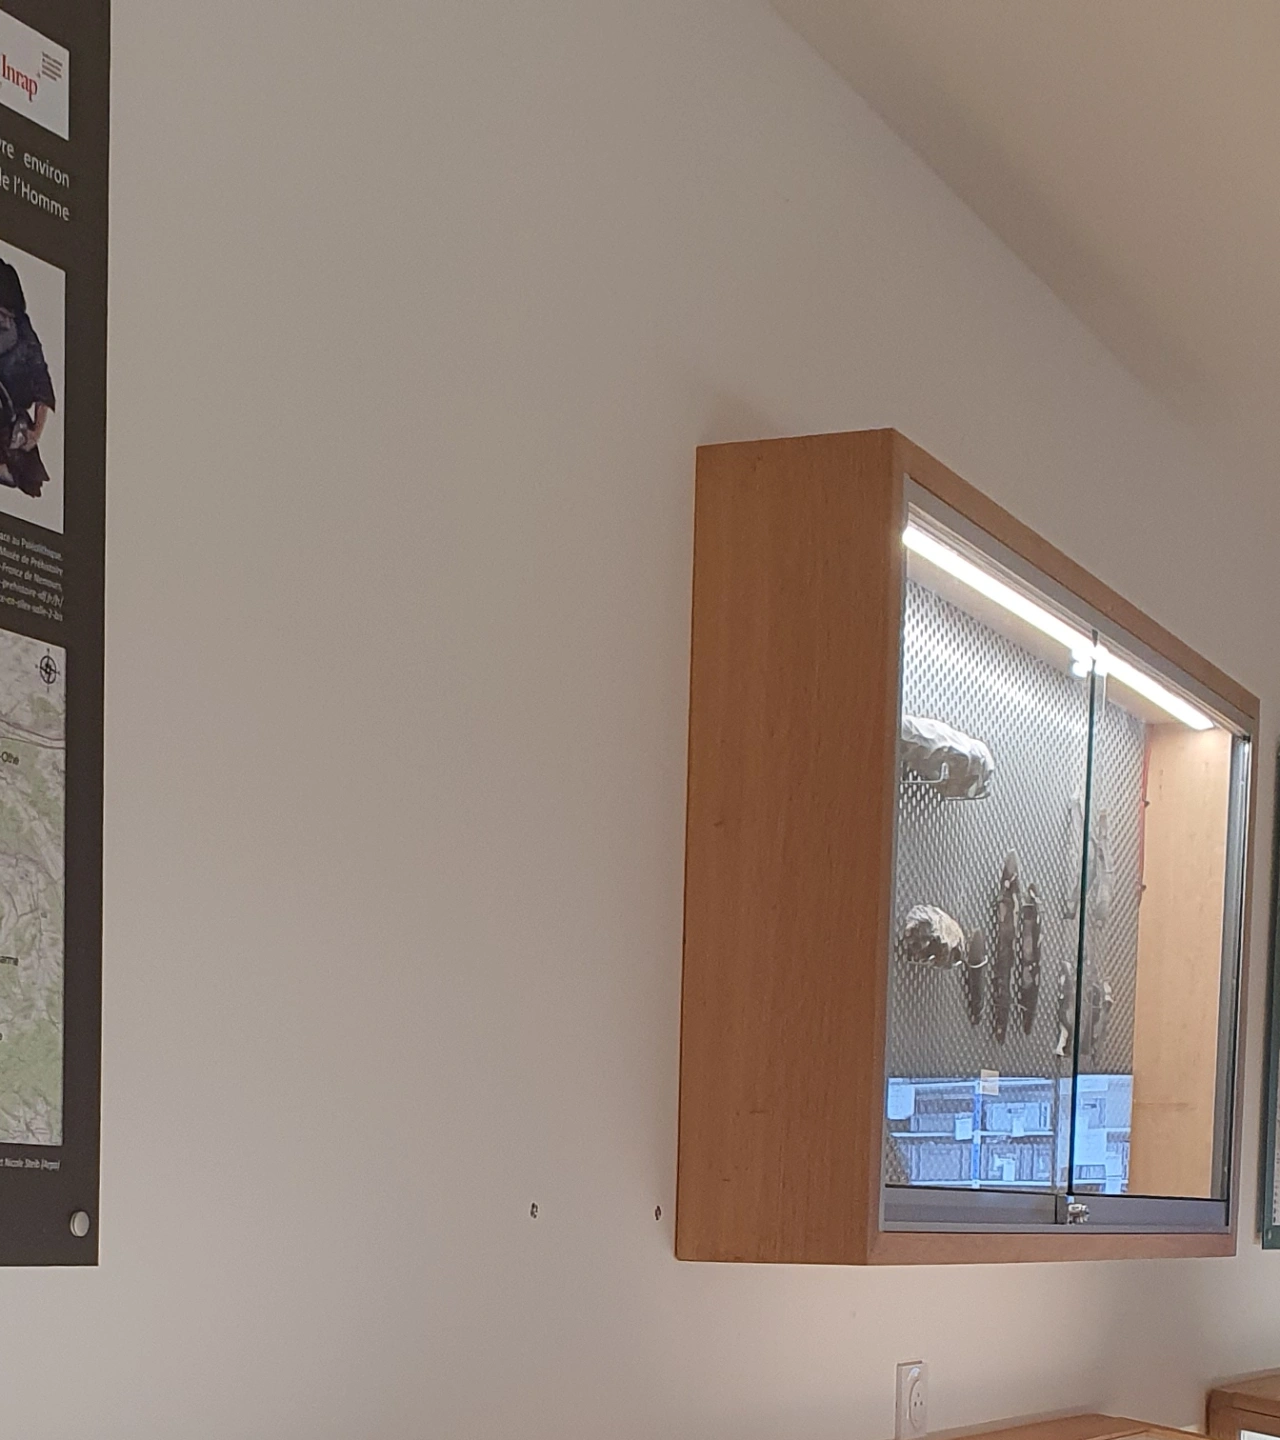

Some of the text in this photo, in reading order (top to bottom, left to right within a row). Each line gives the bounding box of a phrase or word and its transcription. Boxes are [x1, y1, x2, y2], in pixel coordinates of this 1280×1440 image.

[1, 53, 38, 102] Inrap
[23, 151, 70, 189] environ
[13, 174, 70, 222] l'Homme
